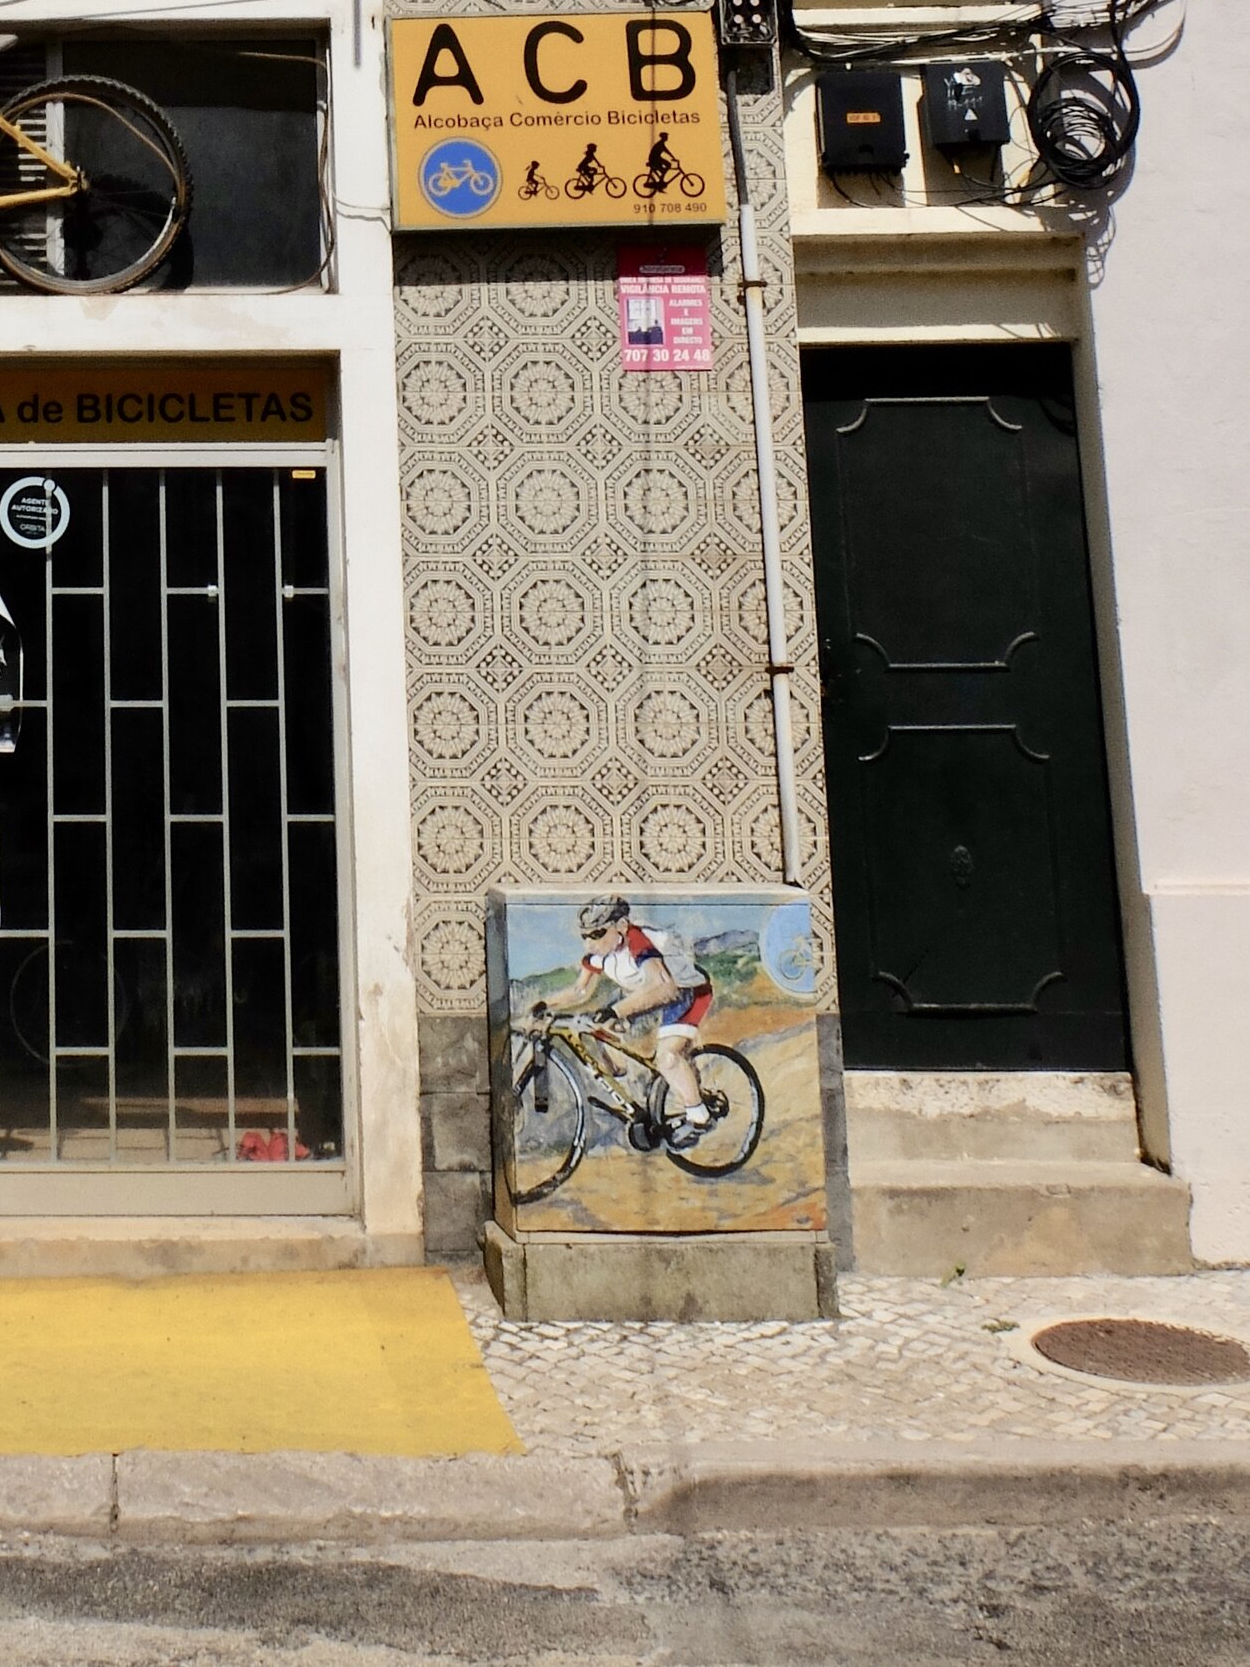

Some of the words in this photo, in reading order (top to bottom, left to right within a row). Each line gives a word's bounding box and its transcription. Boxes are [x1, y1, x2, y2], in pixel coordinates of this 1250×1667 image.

[413, 114, 504, 131] Alcobaça
[509, 111, 602, 127] Comércio
[607, 109, 701, 125] Bicicletas
[633, 203, 656, 214] 910
[659, 203, 682, 213] 708
[685, 202, 707, 213] 490
[620, 283, 669, 294] VIGILÂNCIA
[671, 284, 707, 294] REMOTA
[623, 349, 648, 362] 707
[652, 349, 670, 362] 30
[673, 349, 690, 362] 24
[693, 349, 710, 362] 48
[17, 393, 64, 423] de
[76, 391, 314, 423] BICICLETAS
